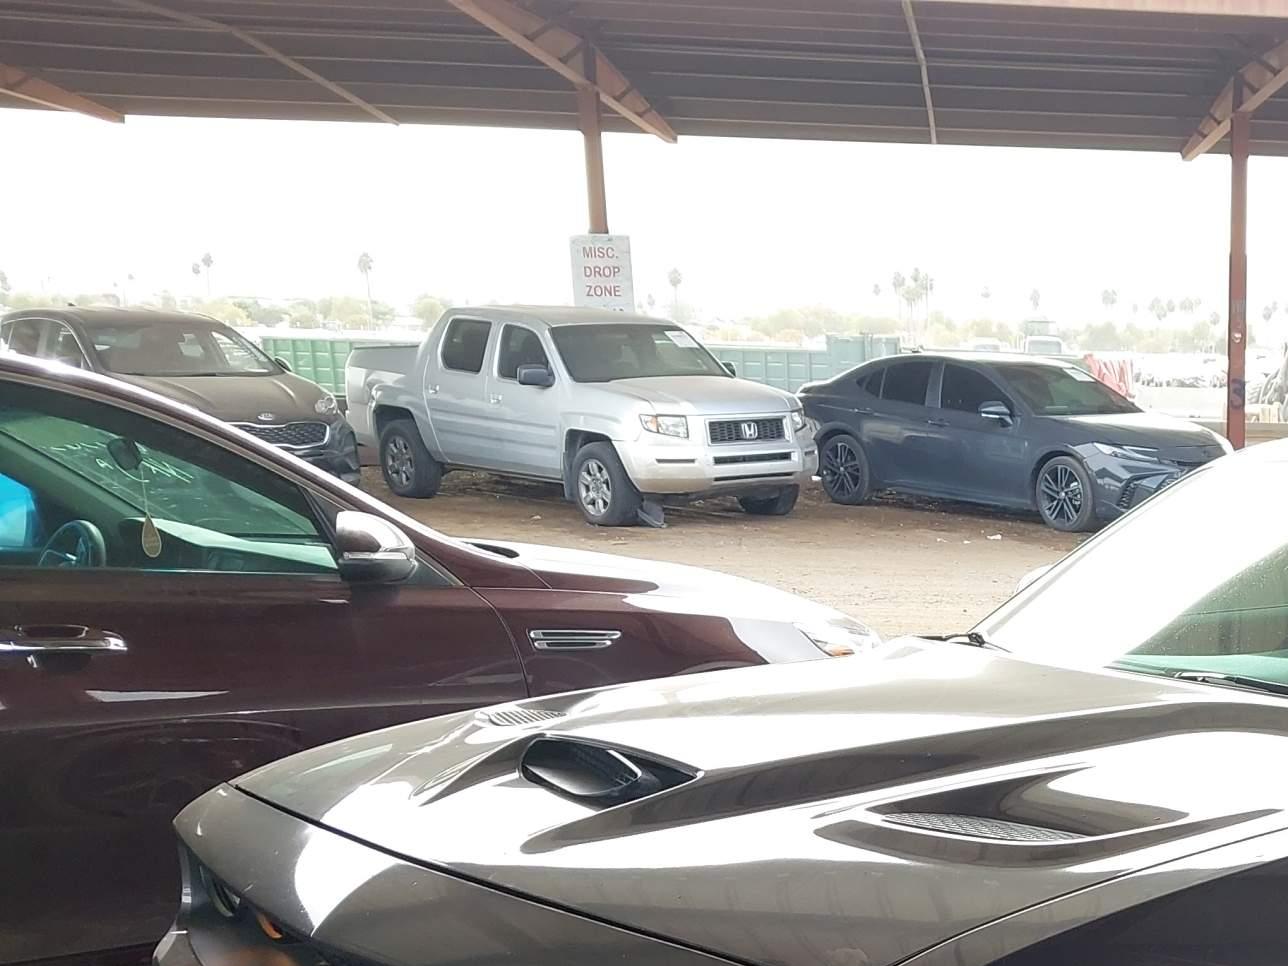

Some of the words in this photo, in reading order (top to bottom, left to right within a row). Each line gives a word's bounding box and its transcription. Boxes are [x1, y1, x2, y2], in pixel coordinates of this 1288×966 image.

[582, 246, 619, 259] MISC.
[583, 265, 621, 278] DROP
[585, 284, 622, 297] ZONE
